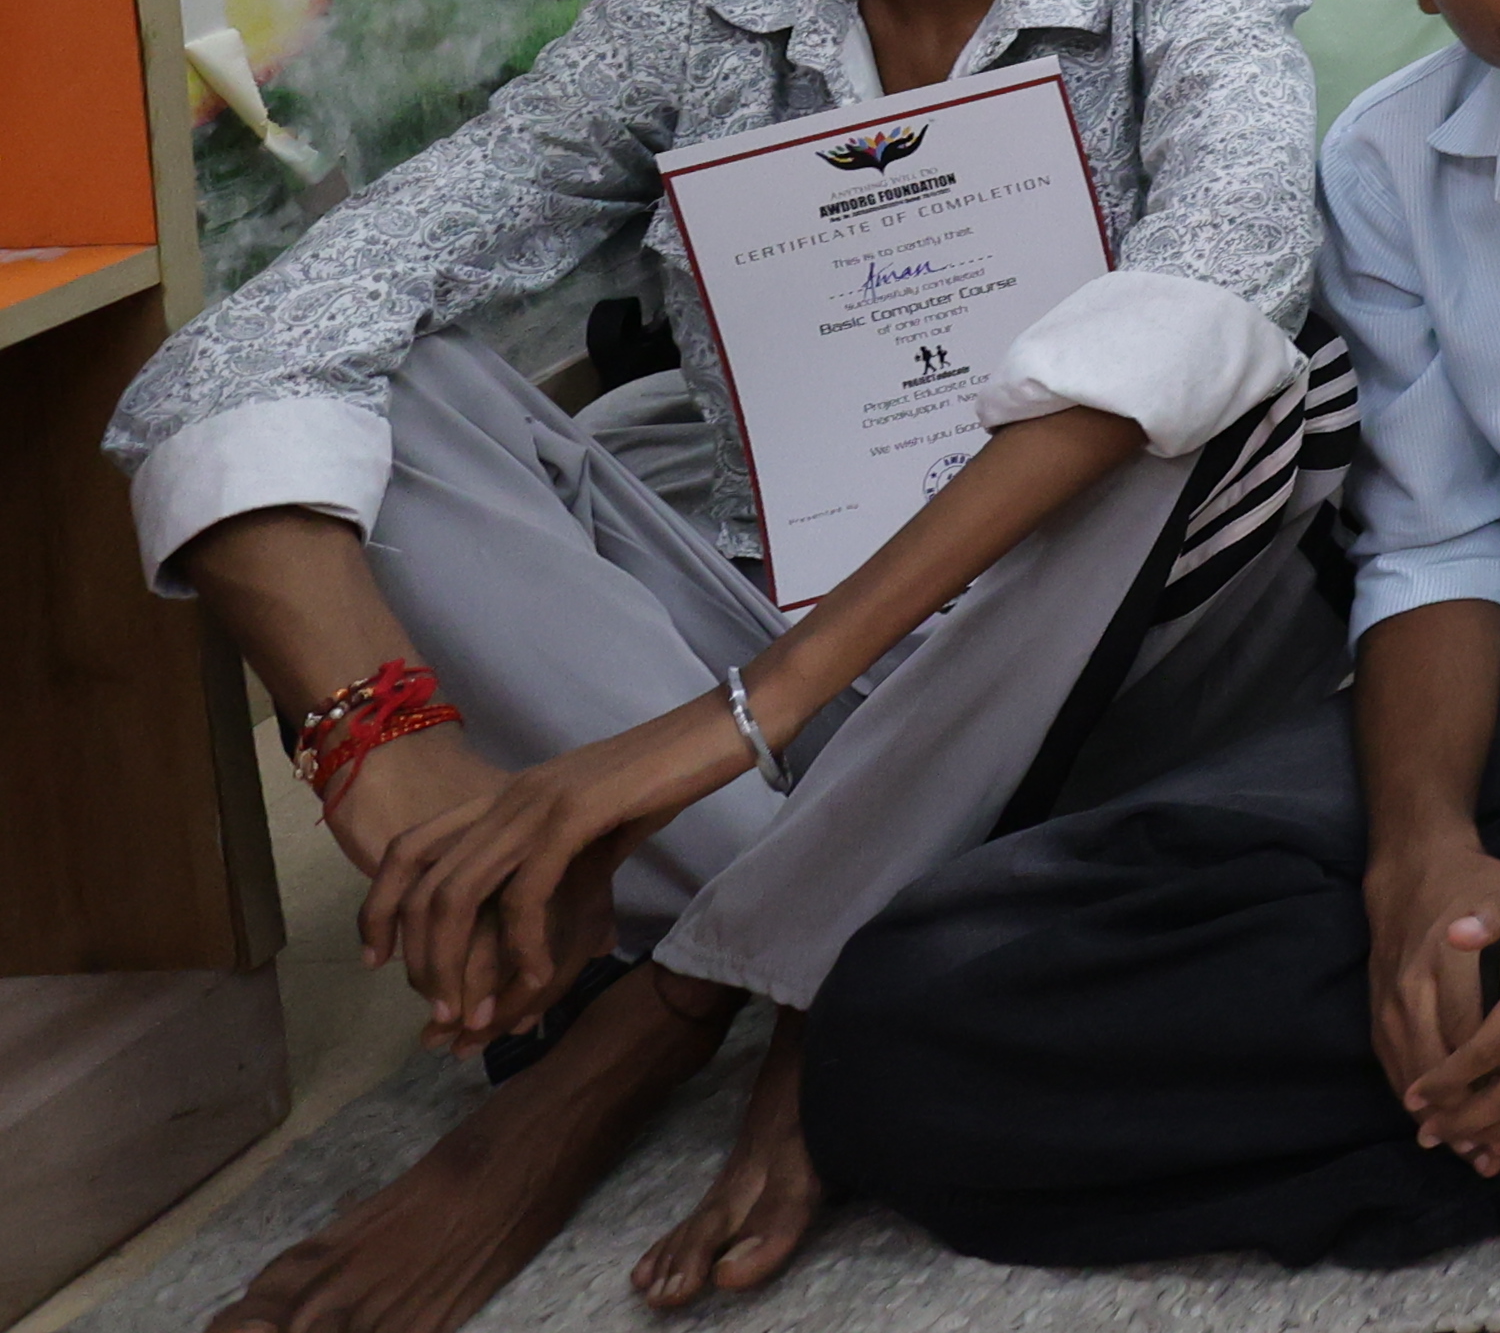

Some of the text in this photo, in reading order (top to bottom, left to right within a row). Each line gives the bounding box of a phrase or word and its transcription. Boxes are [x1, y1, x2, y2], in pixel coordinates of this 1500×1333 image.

[735, 221, 871, 266] CERTIFICATE
[882, 212, 908, 227] OF
[918, 175, 1052, 218] COMPLETION
[818, 193, 876, 219] AWDORG
[879, 173, 956, 206] FOUNDATION
[819, 277, 1017, 336] Basic Computer Course
